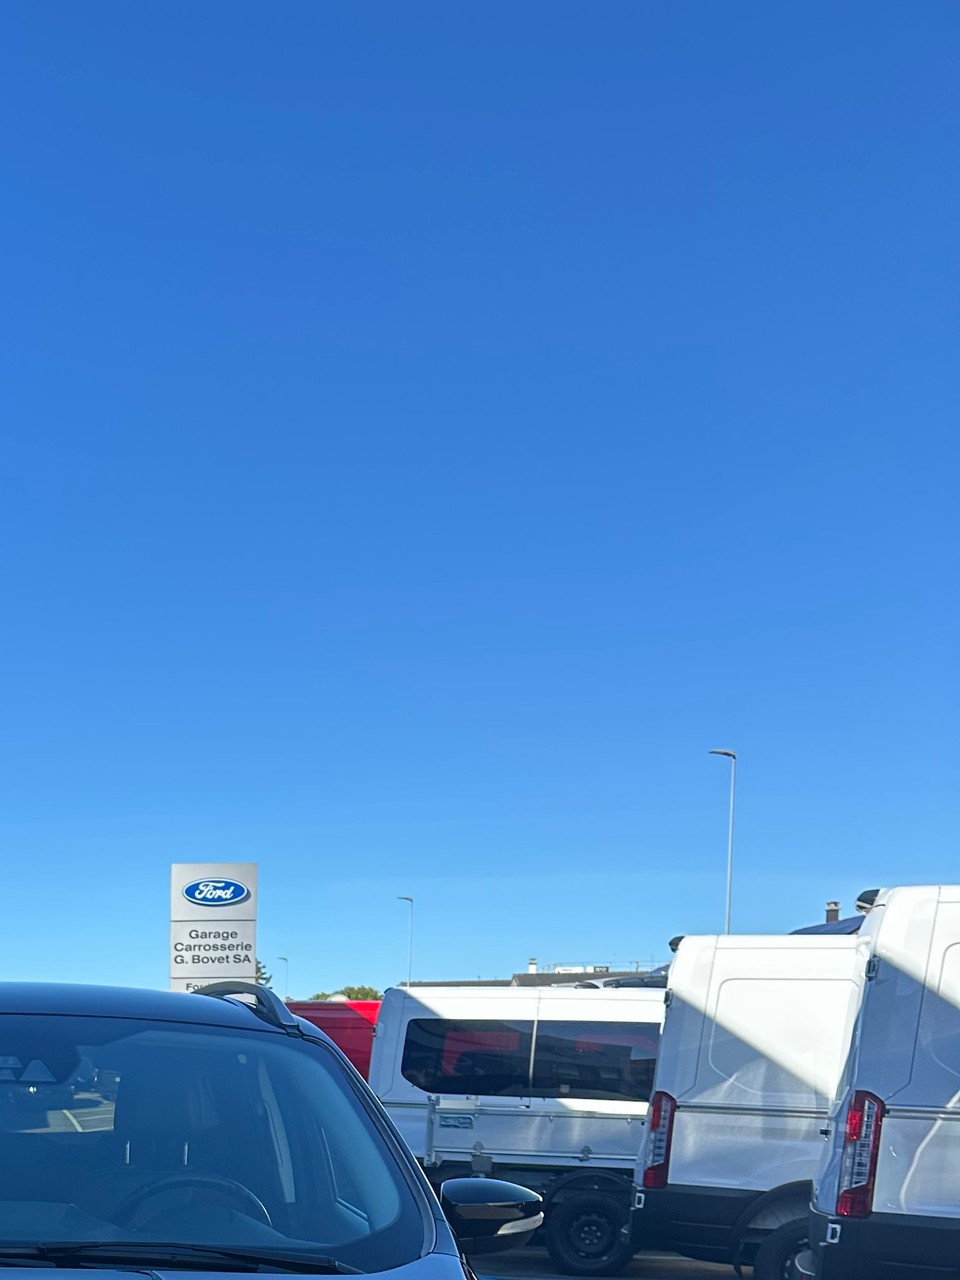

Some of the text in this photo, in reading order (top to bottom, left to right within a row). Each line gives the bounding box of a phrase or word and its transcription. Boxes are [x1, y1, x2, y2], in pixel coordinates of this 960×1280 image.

[194, 881, 235, 899] Ford
[188, 929, 238, 941] Garage
[173, 941, 253, 952] Carrosserie
[173, 954, 252, 964] G. Bovet SA
